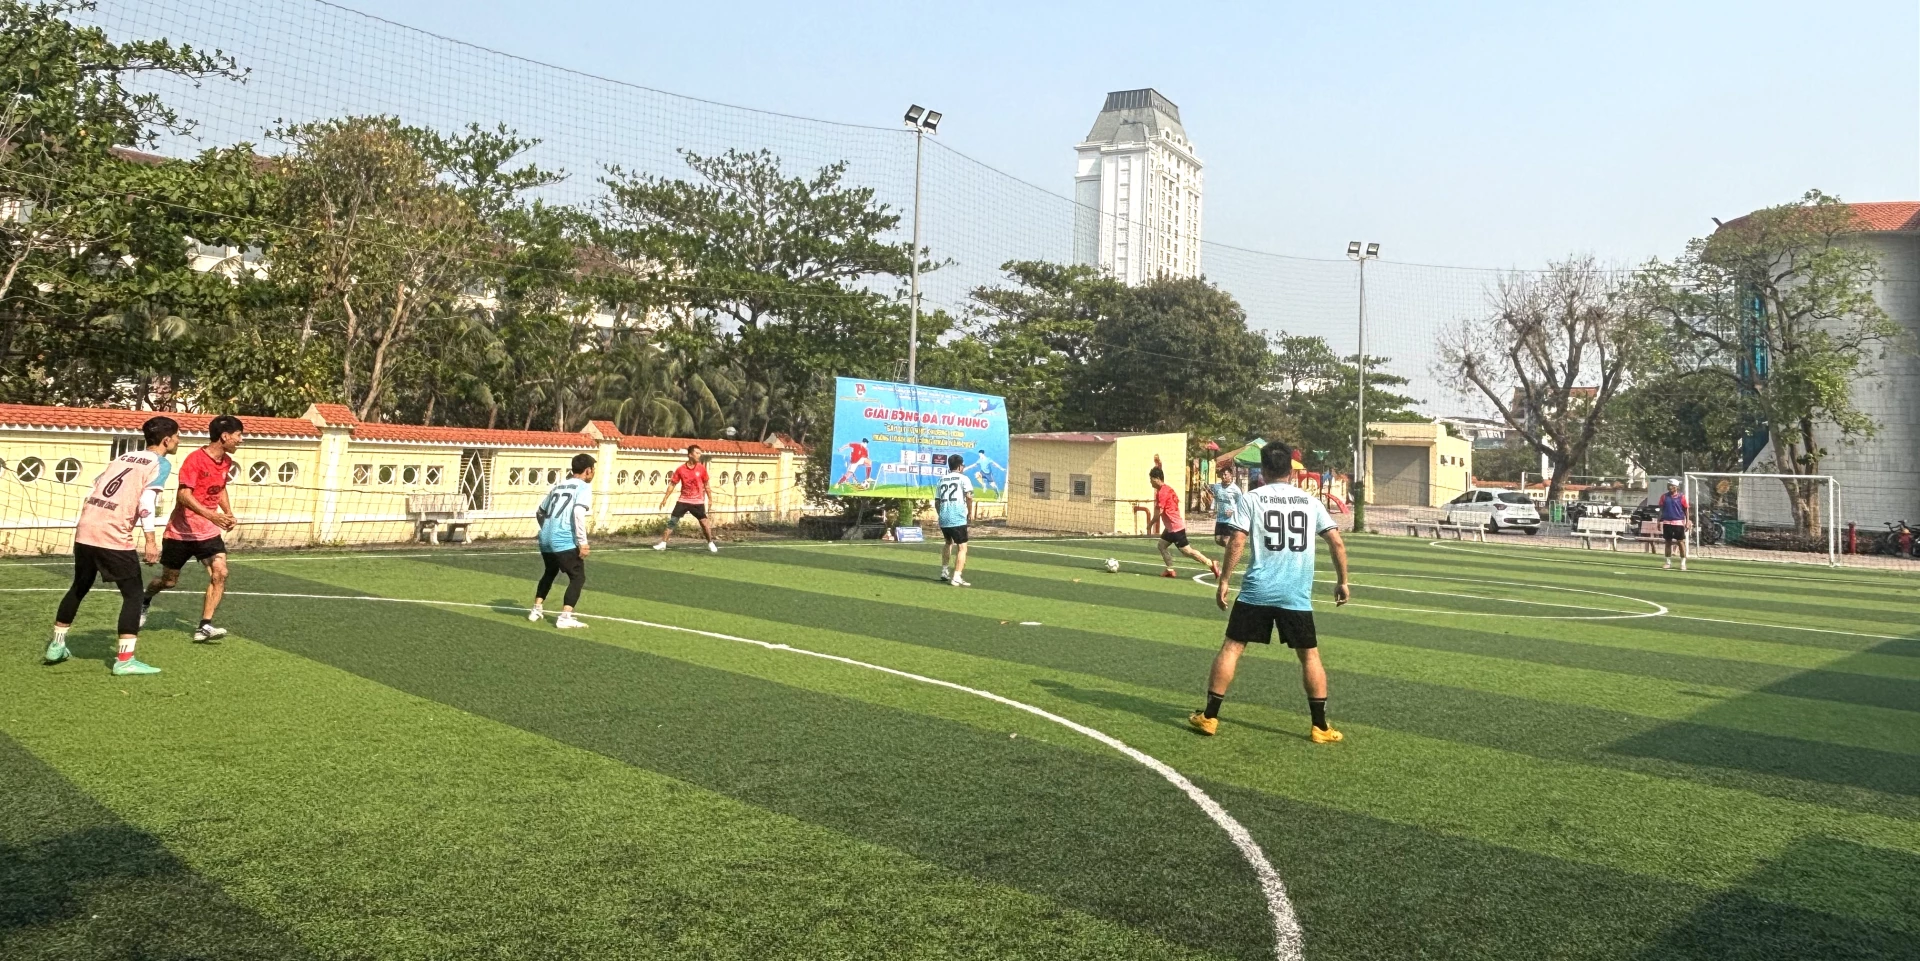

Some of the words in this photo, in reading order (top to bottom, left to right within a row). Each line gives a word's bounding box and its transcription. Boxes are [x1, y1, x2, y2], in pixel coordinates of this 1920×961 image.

[102, 467, 133, 498] 6
[940, 482, 959, 502] 22
[1260, 495, 1268, 504] FC
[1264, 510, 1308, 552] 99
